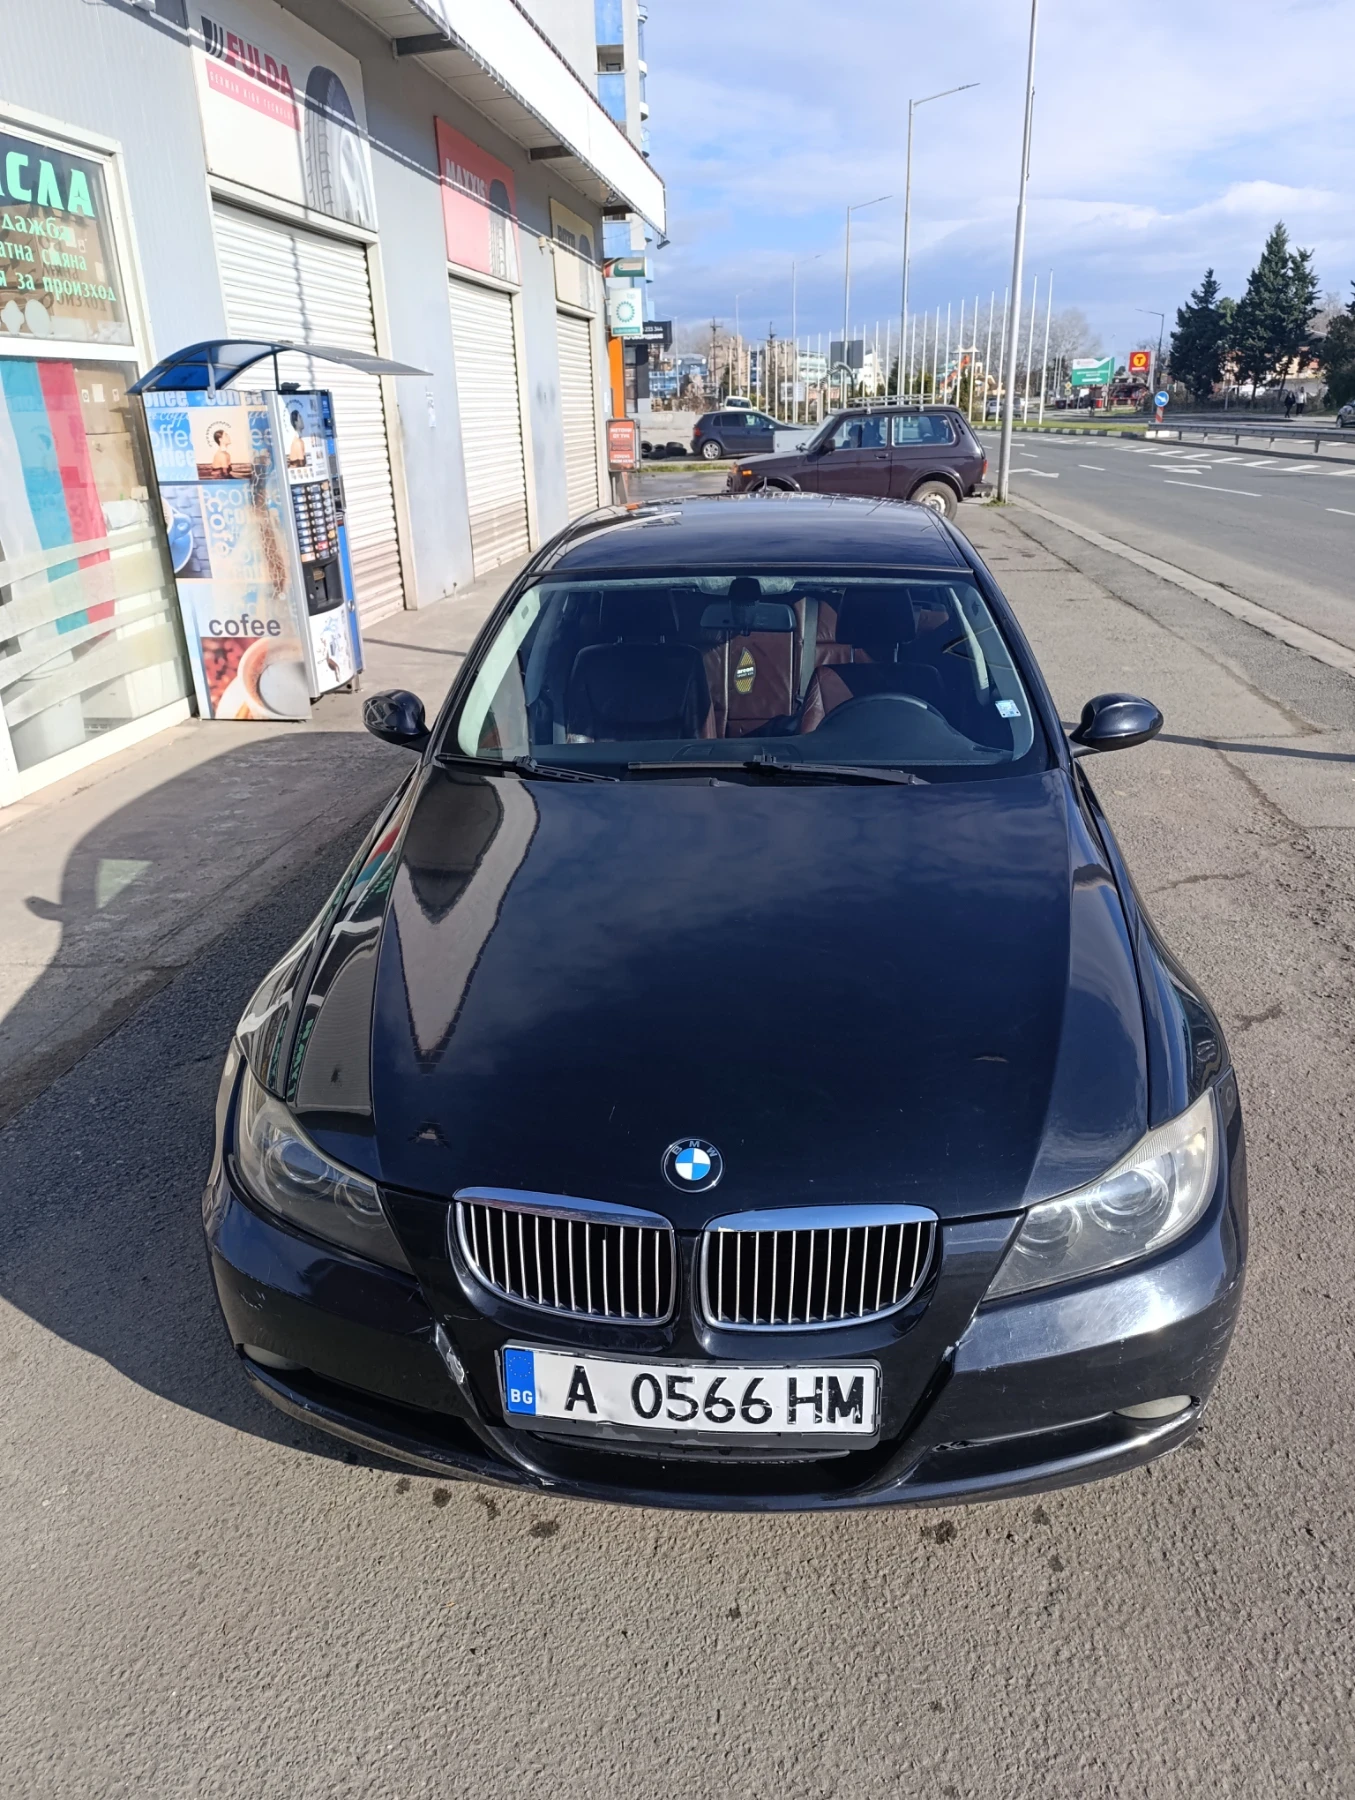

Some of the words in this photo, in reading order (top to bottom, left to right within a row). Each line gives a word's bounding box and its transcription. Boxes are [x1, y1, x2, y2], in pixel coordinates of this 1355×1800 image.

[209, 71, 240, 94] GERMAN
[225, 31, 296, 101] FULDA
[0, 151, 95, 217] СЛА
[445, 157, 486, 207] MAXXIS
[15, 272, 35, 291] за
[43, 276, 116, 302] произход
[208, 613, 281, 636] cofee
[671, 1140, 718, 1157] BMW
[510, 1388, 533, 1405] BG
[564, 1365, 597, 1414] A
[631, 1372, 773, 1424] 0566
[788, 1375, 864, 1425] HM
